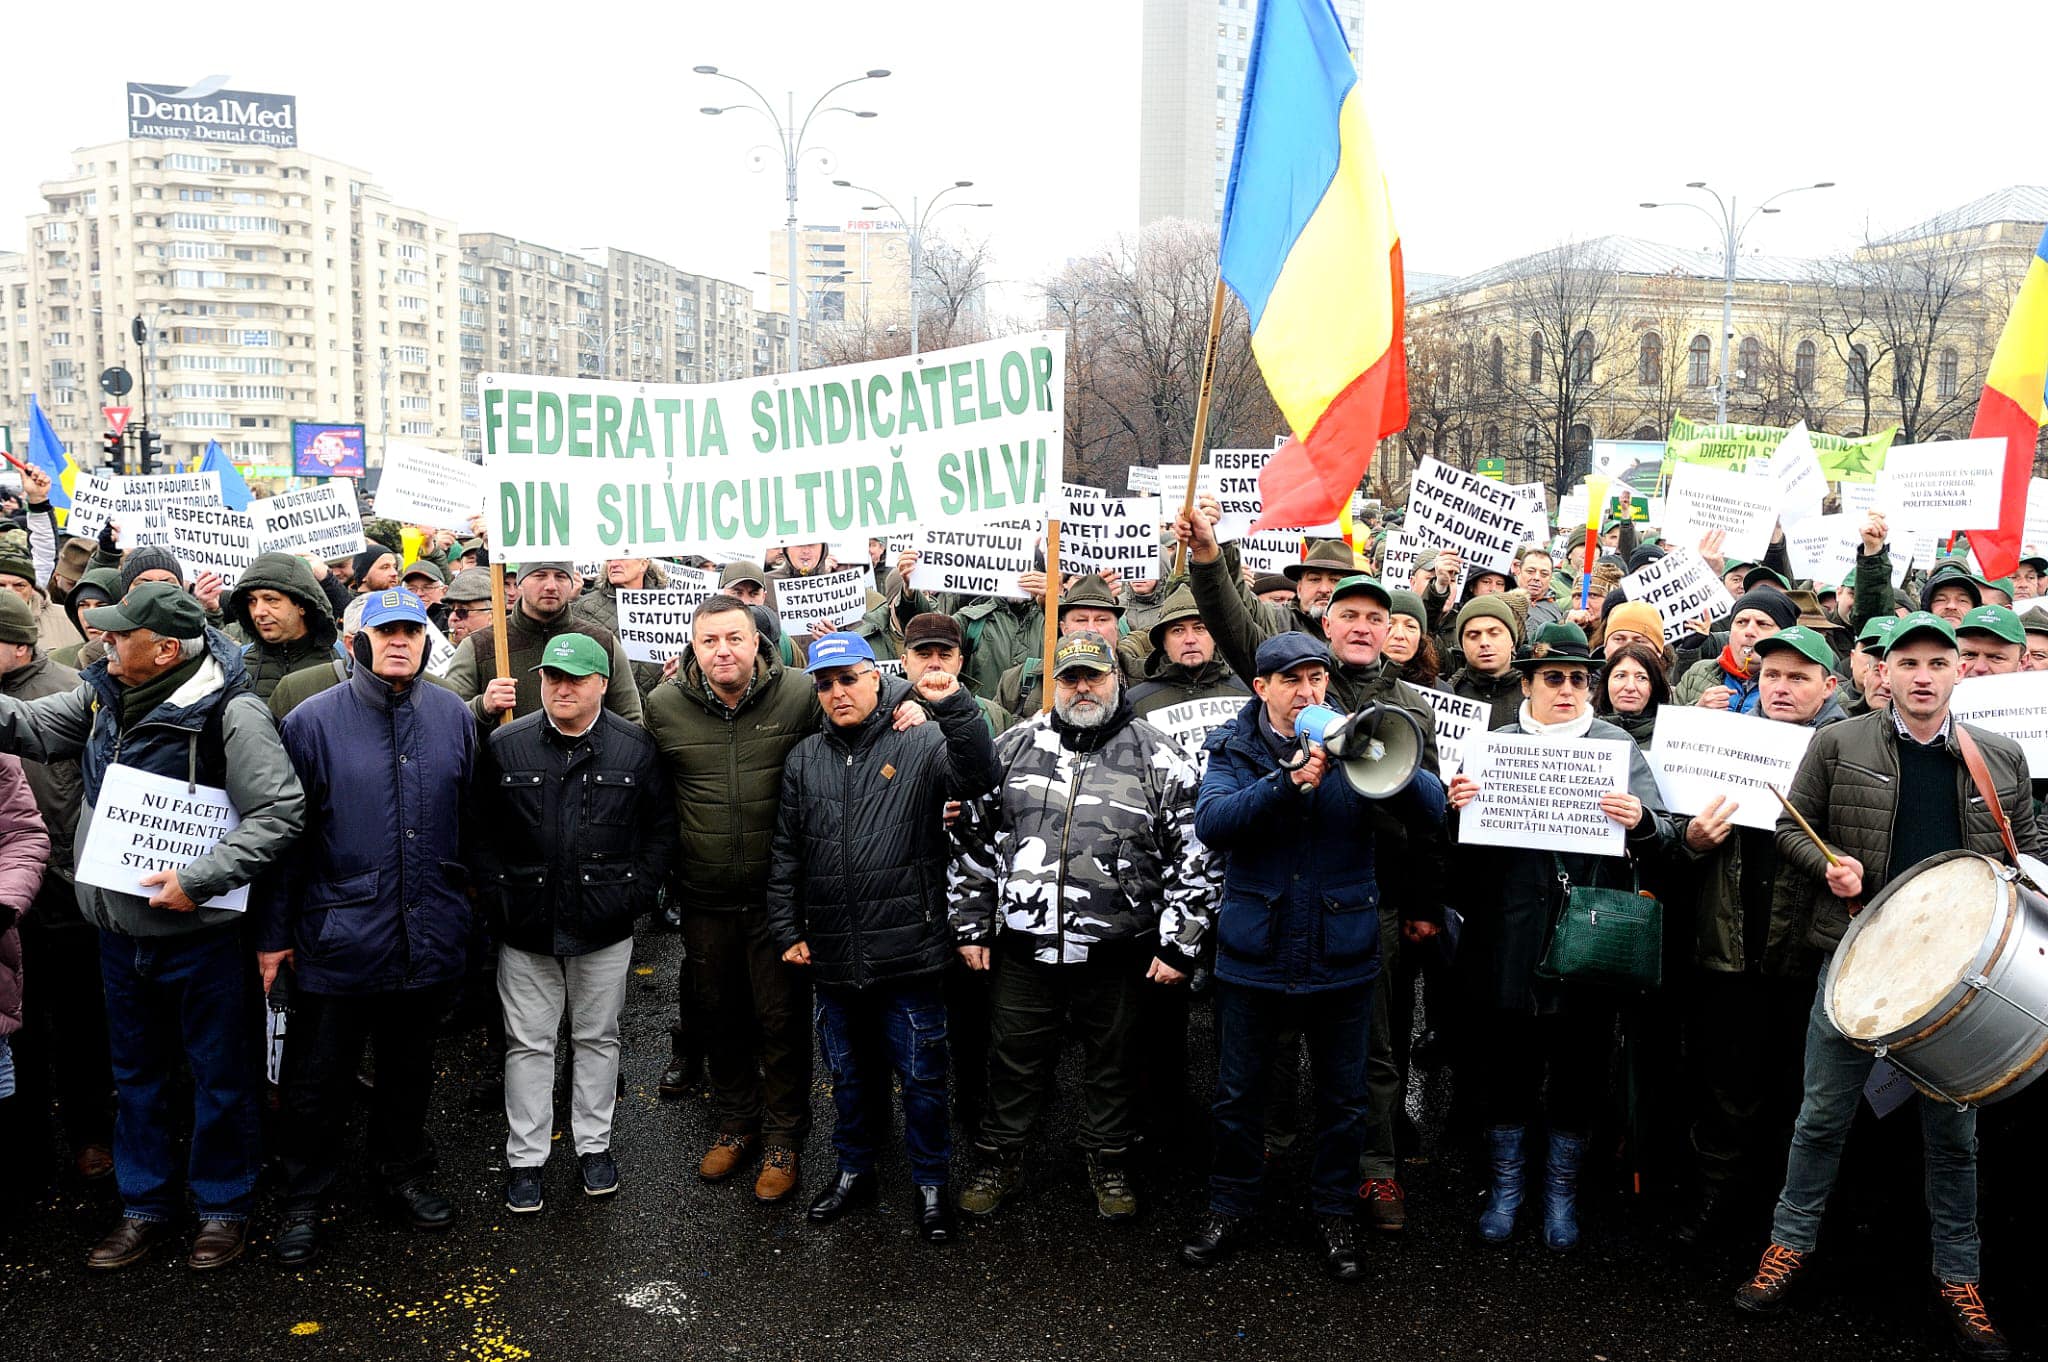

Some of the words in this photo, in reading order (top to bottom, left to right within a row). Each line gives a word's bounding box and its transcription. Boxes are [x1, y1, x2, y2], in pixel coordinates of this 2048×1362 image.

[130, 92, 293, 129] DentalMed
[196, 125, 245, 142] Dental
[250, 128, 293, 145] Clinic
[751, 346, 1053, 453] SINDICATELOR
[1215, 453, 1274, 469] RESPEC
[90, 478, 109, 492] NU
[1434, 465, 1458, 485] NU
[1461, 476, 1516, 512] FACEȚI
[272, 498, 286, 511] NU
[500, 481, 570, 547] DIN
[597, 444, 917, 546] SILVICULTURĂ
[75, 507, 92, 520] CU
[115, 499, 142, 513] GRIJA
[1070, 502, 1095, 517] NU
[1101, 500, 1126, 517] VĂ
[1415, 479, 1525, 536] EXPERIMENTE
[145, 516, 158, 529] NU
[168, 506, 254, 530] RESPECTAREA
[266, 503, 351, 533] ROMSILVA,
[1413, 501, 1432, 519] CU
[1434, 511, 1514, 554] PĂDURILE
[174, 527, 249, 549] STATUTULUI
[926, 530, 1022, 551] STATUTULUI
[1060, 521, 1109, 543] ATEȚI
[1115, 524, 1151, 539] JOC
[1400, 534, 1418, 546] NU
[263, 534, 307, 553] GARANTUL
[1071, 542, 1158, 560] PĂDURILE
[1240, 537, 1300, 554] NALULUI
[917, 550, 1032, 573] PERSONALULUI
[778, 570, 861, 592] RESPECTAREA
[1386, 566, 1404, 579] CU
[1638, 565, 1662, 586] NU
[943, 574, 999, 592] SILVIC!
[786, 585, 857, 606] STATUTULUI
[780, 597, 865, 620] PERSONALULUI
[1058, 644, 1101, 659] PATRIOT
[1167, 705, 1194, 725] NU
[1972, 706, 2047, 720] EXPERIMENTE
[1487, 743, 1540, 757] PĂDURILE
[1542, 748, 1571, 759] SUNT
[1572, 750, 1595, 760] BUN
[1597, 751, 1613, 761] DE
[1666, 739, 1679, 749] NU
[1717, 747, 1792, 770] EXPERIMENTE
[1495, 758, 1539, 769] INTERES
[1542, 761, 1596, 774] NAȚIONAL
[1663, 763, 1675, 773] CU
[1676, 763, 1727, 781] PĂDURILE
[1480, 769, 1537, 781] ACȚIUNILE
[1539, 772, 1566, 783] CARE
[1568, 775, 1615, 787] LEZEAZĂ
[1484, 781, 1547, 794] INTERESELE
[142, 793, 168, 809] NU
[171, 799, 229, 822] FACEȚI
[1475, 793, 1495, 803] ALE
[1496, 794, 1549, 807] ROMÂNIEI
[106, 806, 227, 840] EXPERIMENTE
[1482, 806, 1549, 820] AMENINȚĂRI
[1551, 811, 1564, 821] LA
[1567, 812, 1609, 824] ADRESA
[1480, 818, 1546, 833] SECURITĂȚII
[1548, 824, 1610, 838] NAȚIONALE
[131, 832, 213, 857] PĂDURIL
